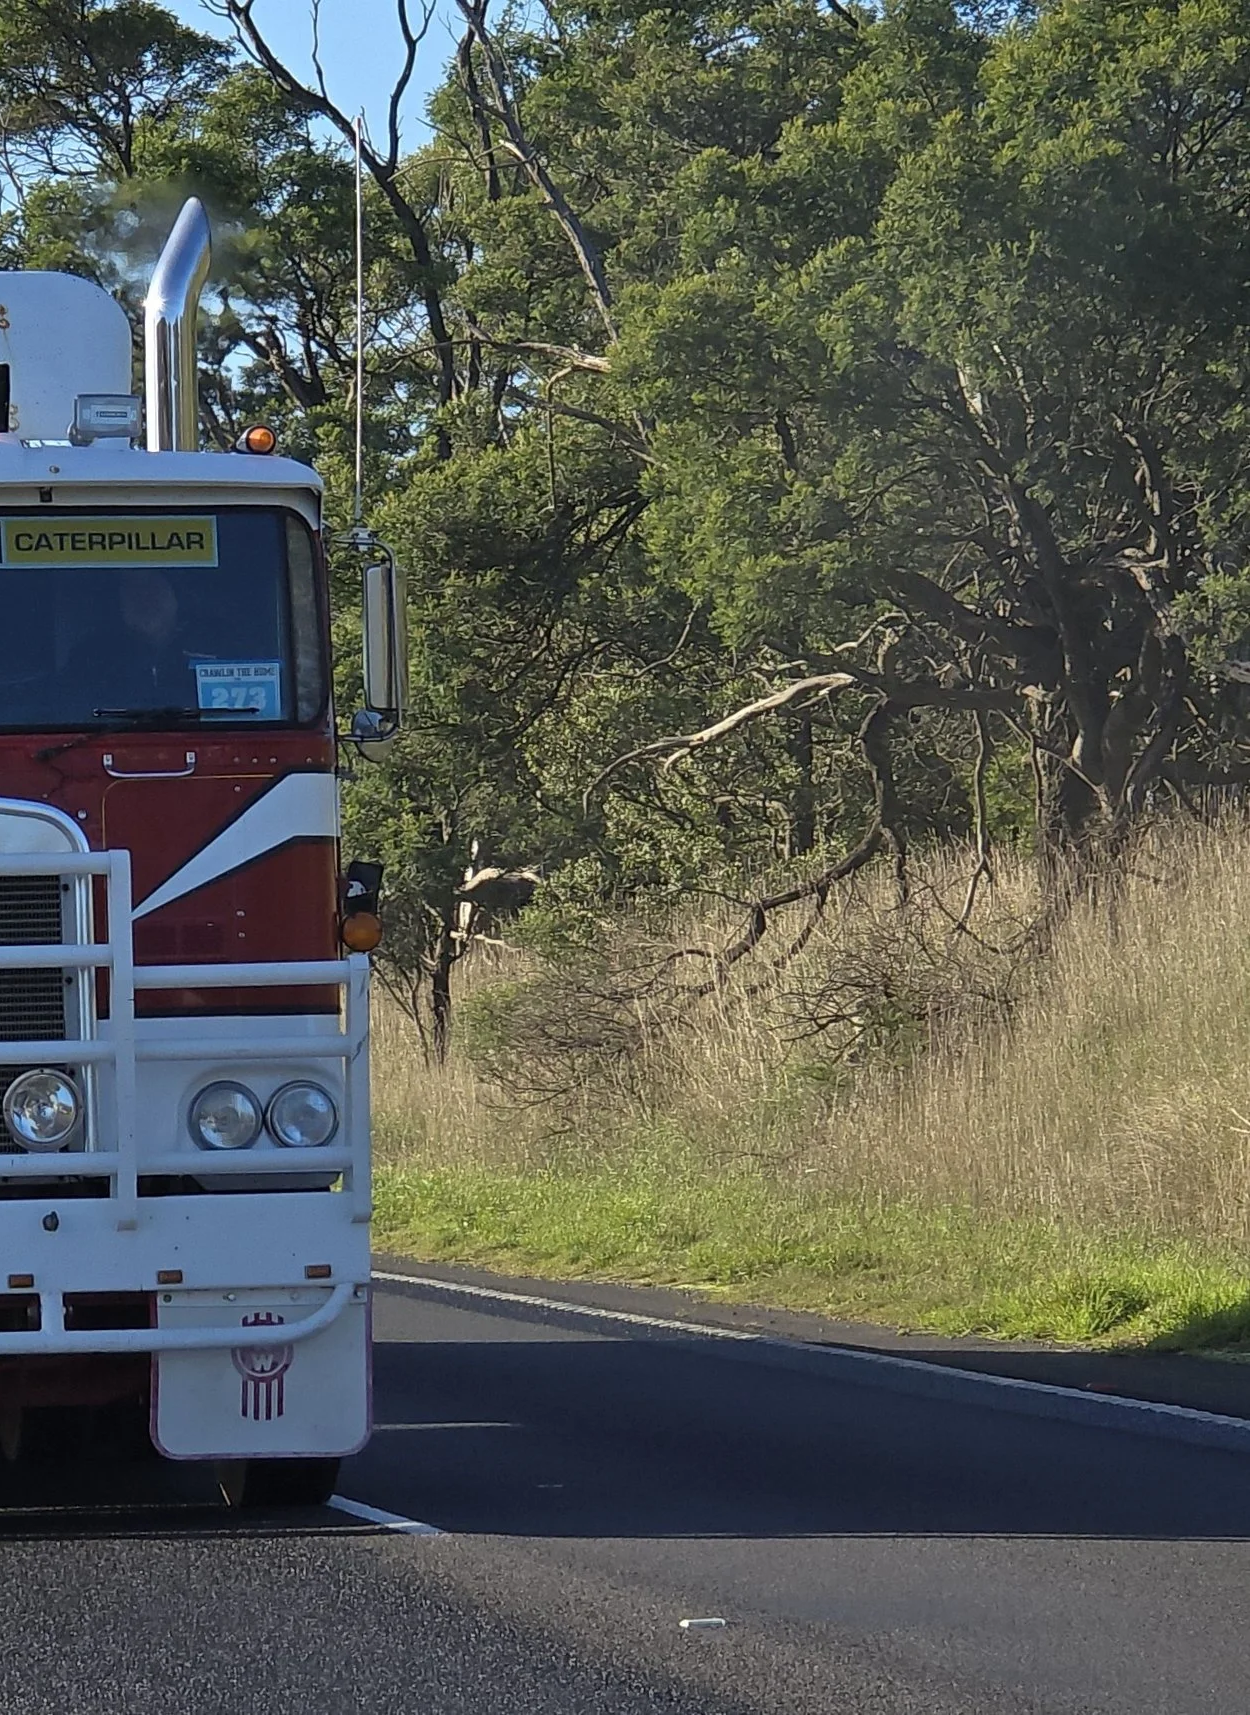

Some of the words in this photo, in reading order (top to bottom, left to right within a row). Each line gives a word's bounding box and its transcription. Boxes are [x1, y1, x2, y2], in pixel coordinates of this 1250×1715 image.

[14, 531, 205, 551] CATERPILLAR
[236, 667, 252, 677] THE
[211, 687, 266, 711] 273
[252, 1354, 274, 1371] W
